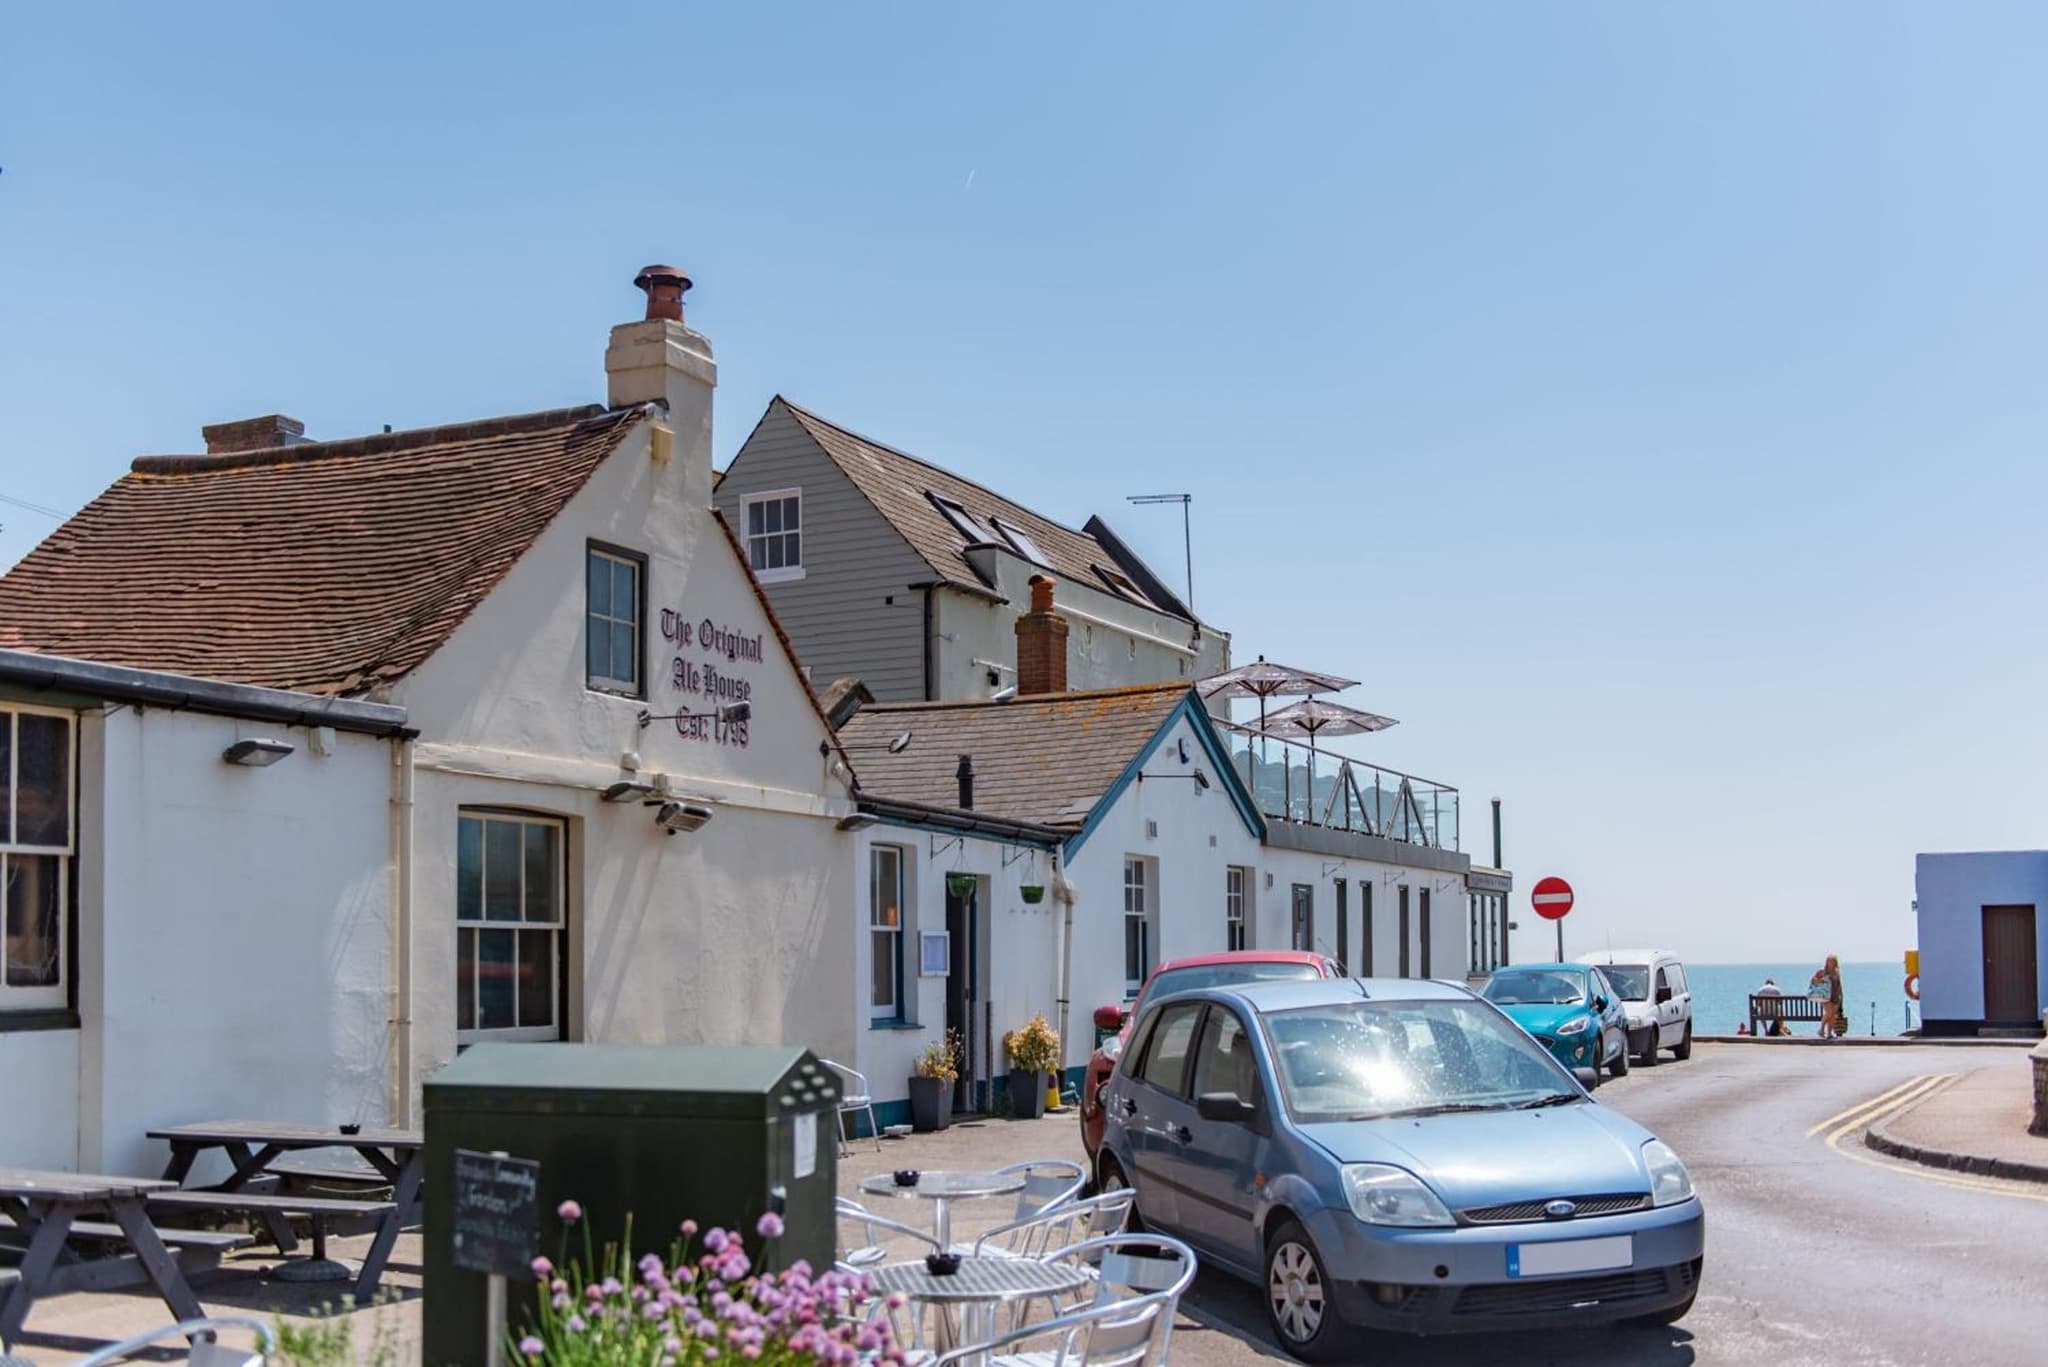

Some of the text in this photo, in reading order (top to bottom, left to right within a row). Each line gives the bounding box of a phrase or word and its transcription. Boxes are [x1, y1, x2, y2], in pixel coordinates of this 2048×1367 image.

[661, 608, 763, 664] The Original
[672, 656, 752, 703] Ale House
